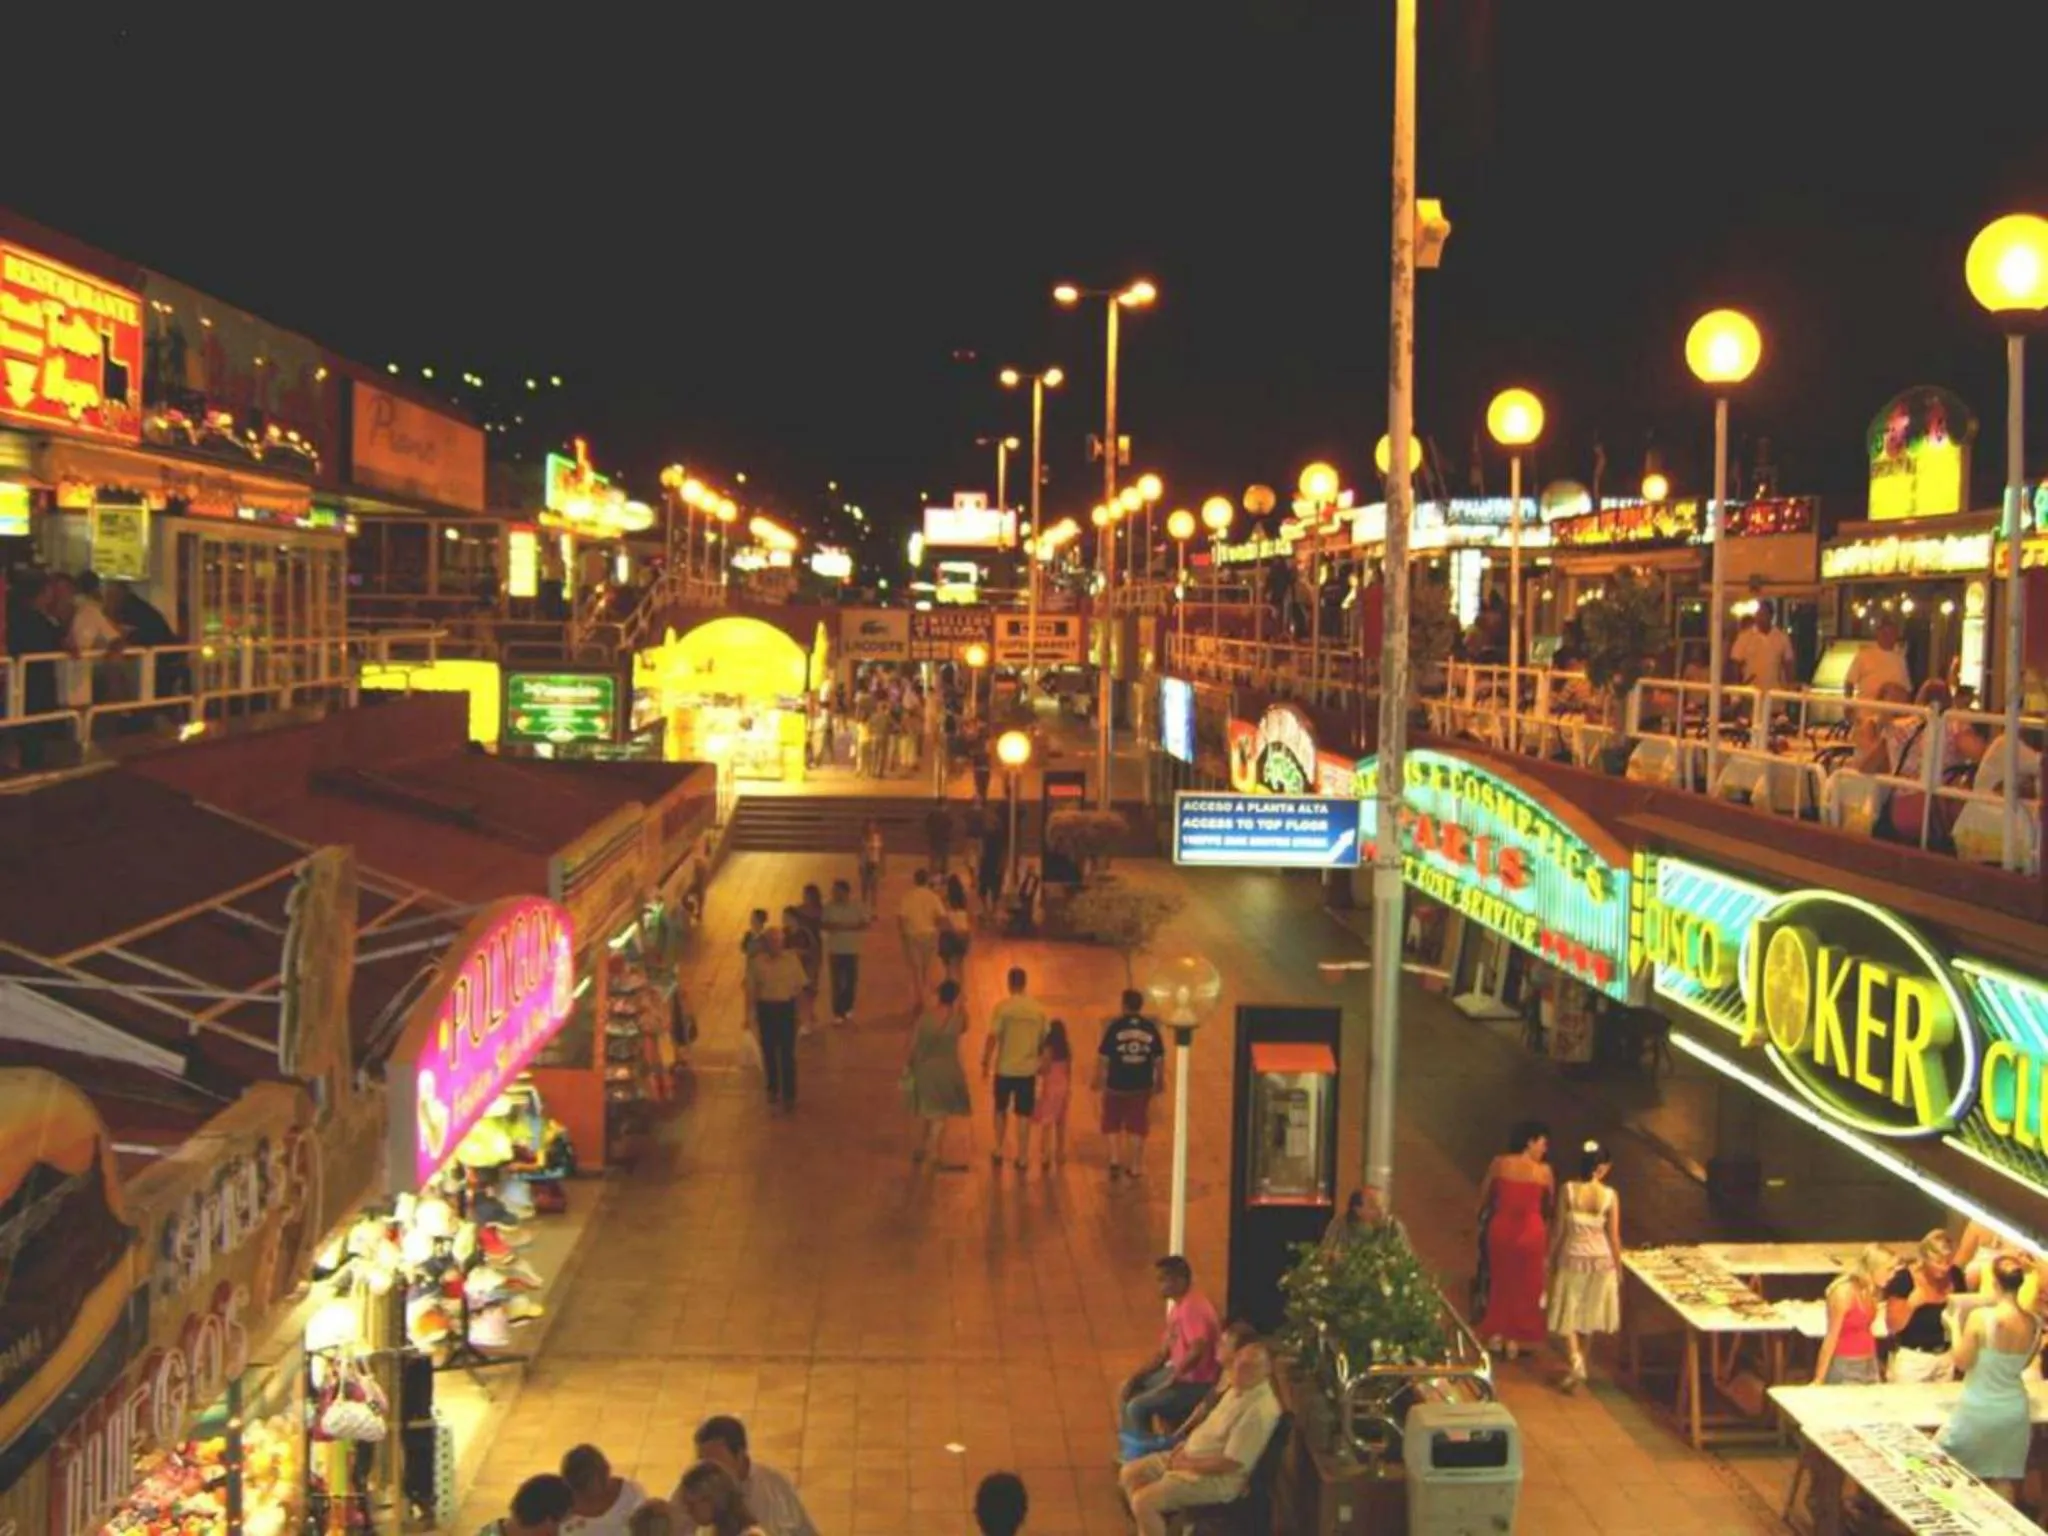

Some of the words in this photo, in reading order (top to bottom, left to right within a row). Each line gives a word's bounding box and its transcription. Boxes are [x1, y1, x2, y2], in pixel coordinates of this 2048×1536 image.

[1182, 801, 1233, 813] ACCESO
[1235, 802, 1245, 812] A
[1247, 802, 1295, 814] PLANTA
[1298, 803, 1328, 814] ALTA
[1182, 817, 1233, 829] ACCESS
[1235, 819, 1253, 830] TO
[1257, 819, 1283, 831] TOP
[1285, 820, 1329, 832] FLOOR
[1450, 769, 1609, 906] COSMETICS
[1645, 897, 1722, 989] DISCO
[1741, 917, 1942, 1128] JOKER
[1982, 1040, 2048, 1157] CL
